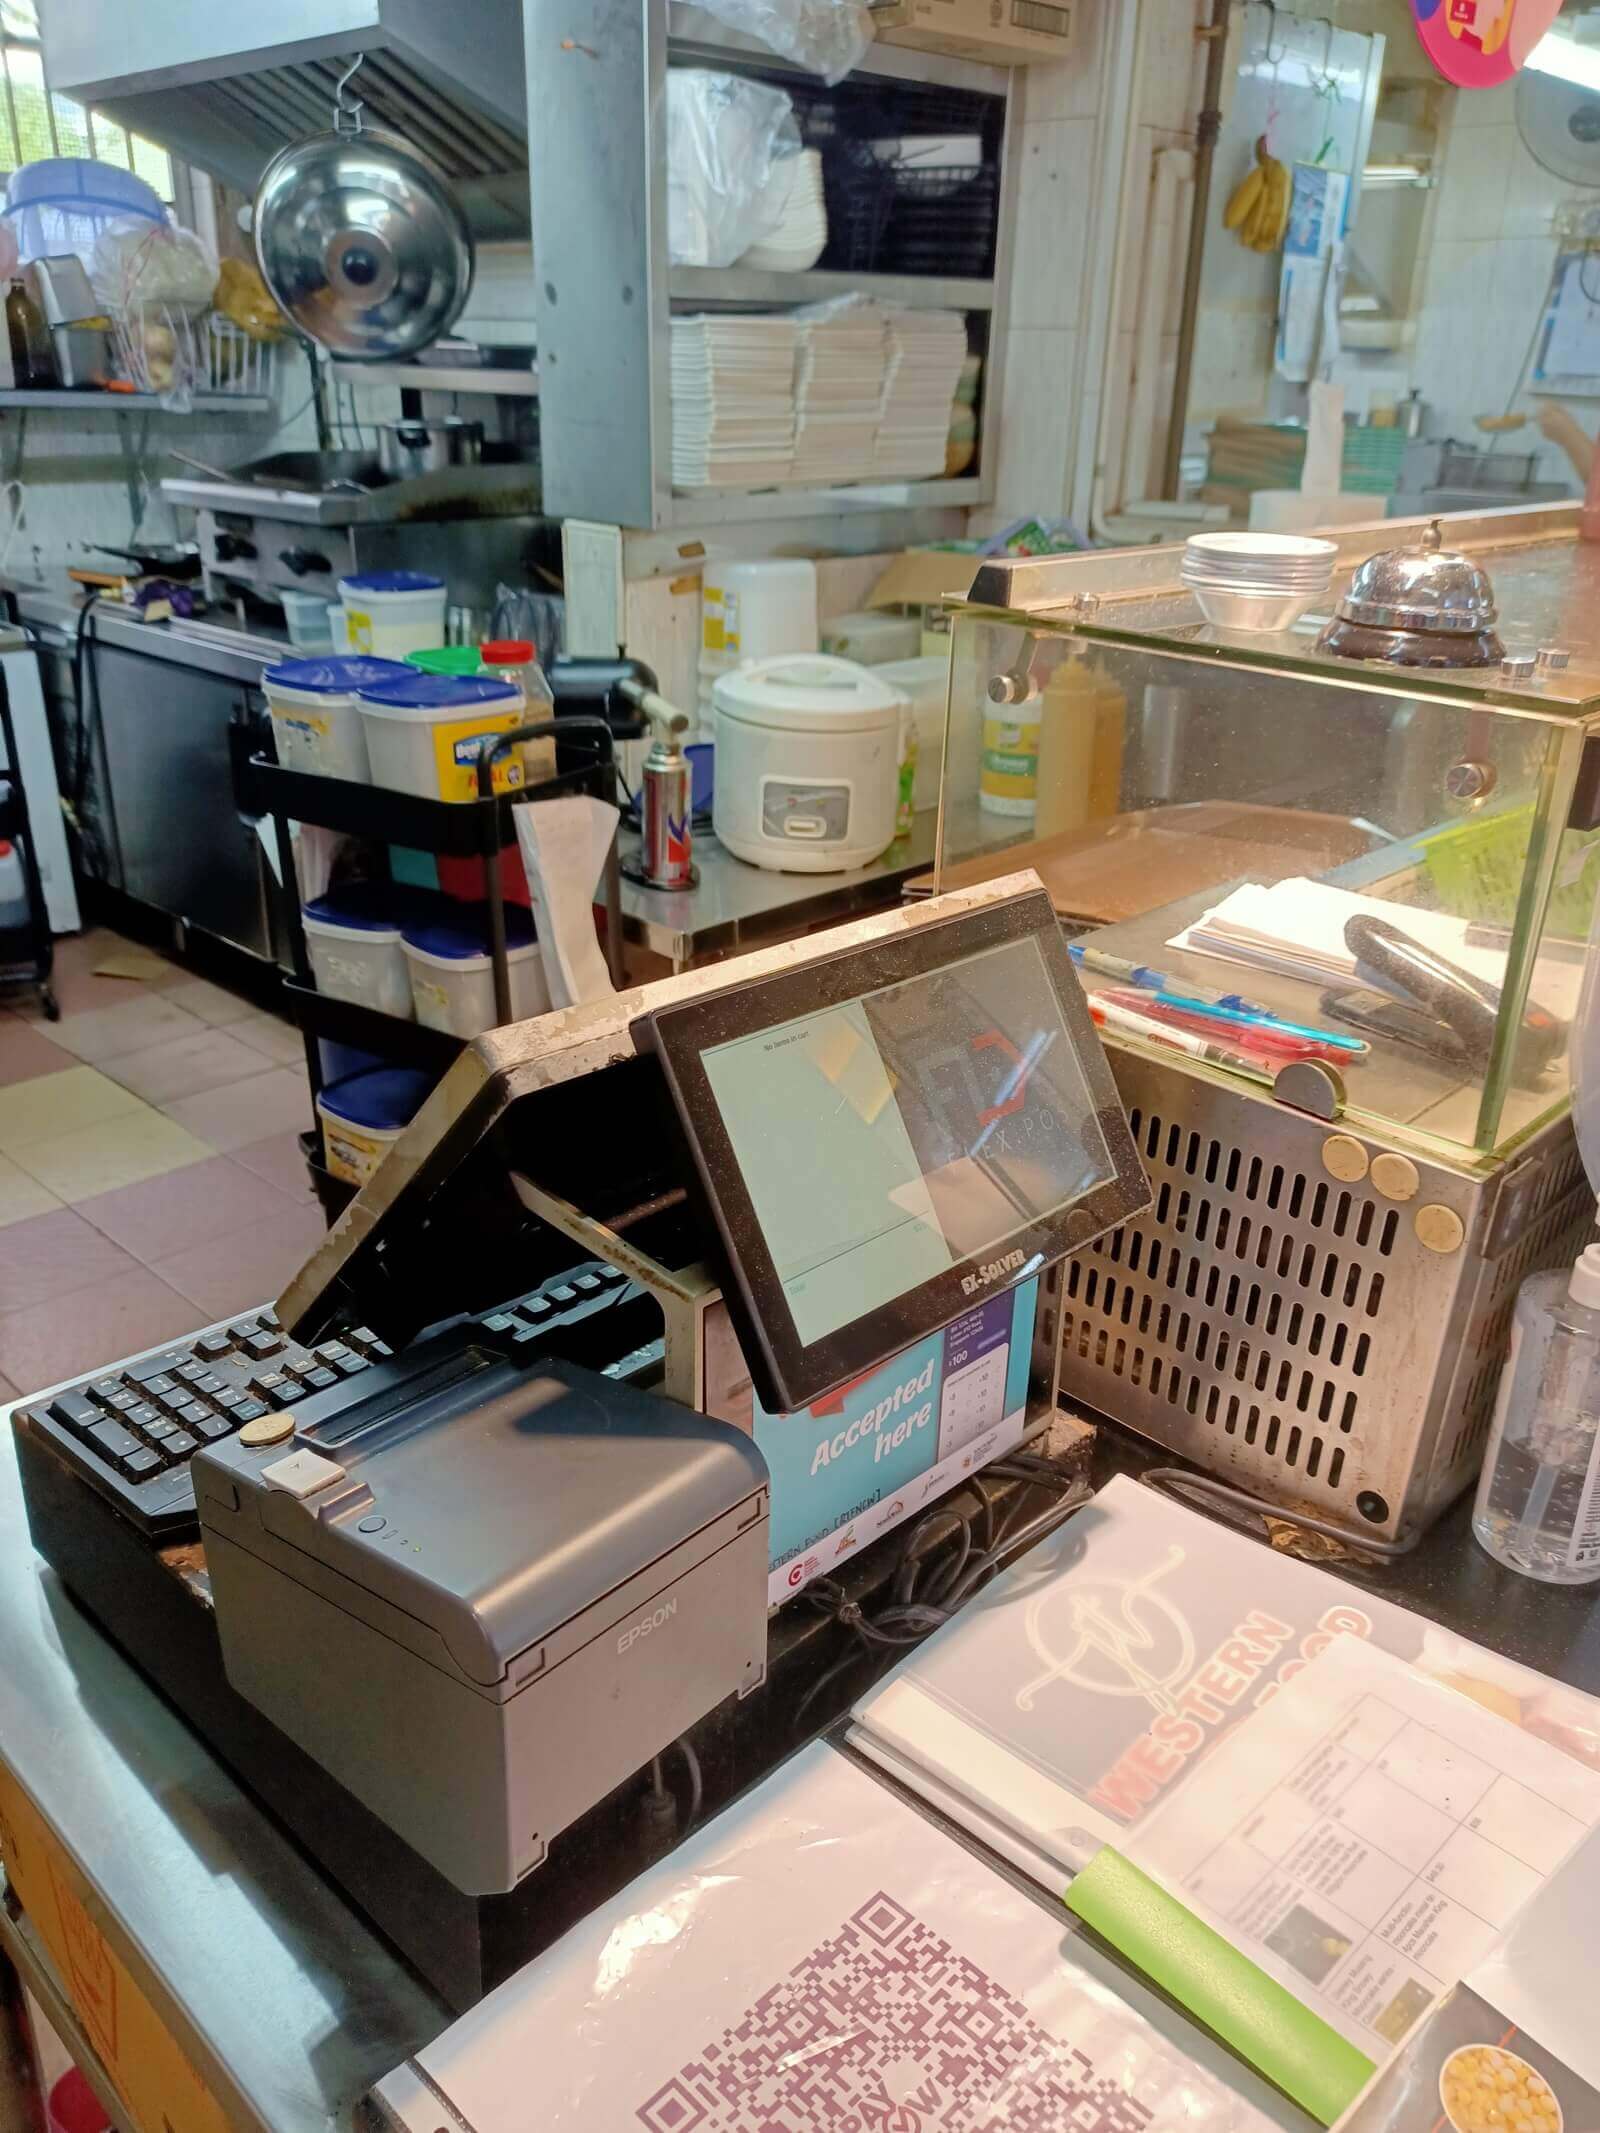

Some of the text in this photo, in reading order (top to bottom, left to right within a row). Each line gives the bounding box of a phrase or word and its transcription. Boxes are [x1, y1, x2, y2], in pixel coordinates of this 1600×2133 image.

[960, 1248, 1027, 1295] EX-SOLVER
[809, 1357, 935, 1476] Accepted
[873, 1402, 933, 1464] here
[616, 1597, 678, 1655] EPSON
[1088, 1608, 1296, 1820] WESTERN
